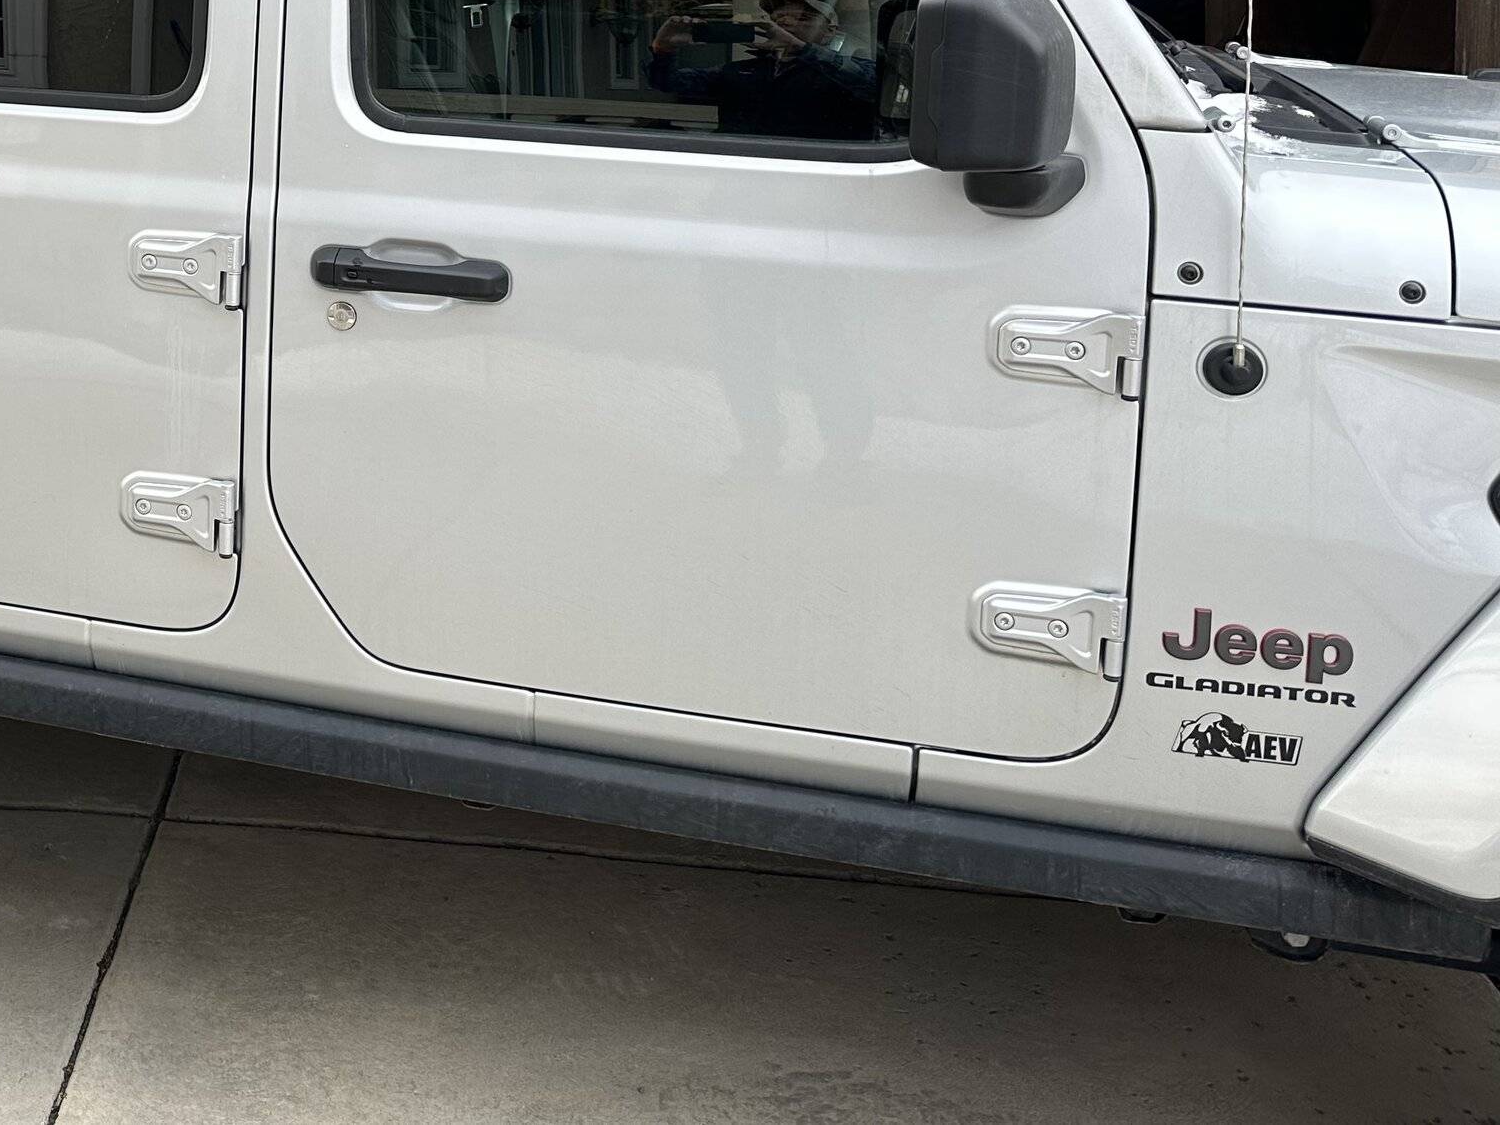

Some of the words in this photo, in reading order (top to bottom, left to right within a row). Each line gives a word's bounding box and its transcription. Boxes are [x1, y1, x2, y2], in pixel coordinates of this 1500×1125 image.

[1162, 607, 1354, 685] Jeep
[1146, 671, 1356, 708] GLADIATOR
[1248, 734, 1299, 762] AEV
